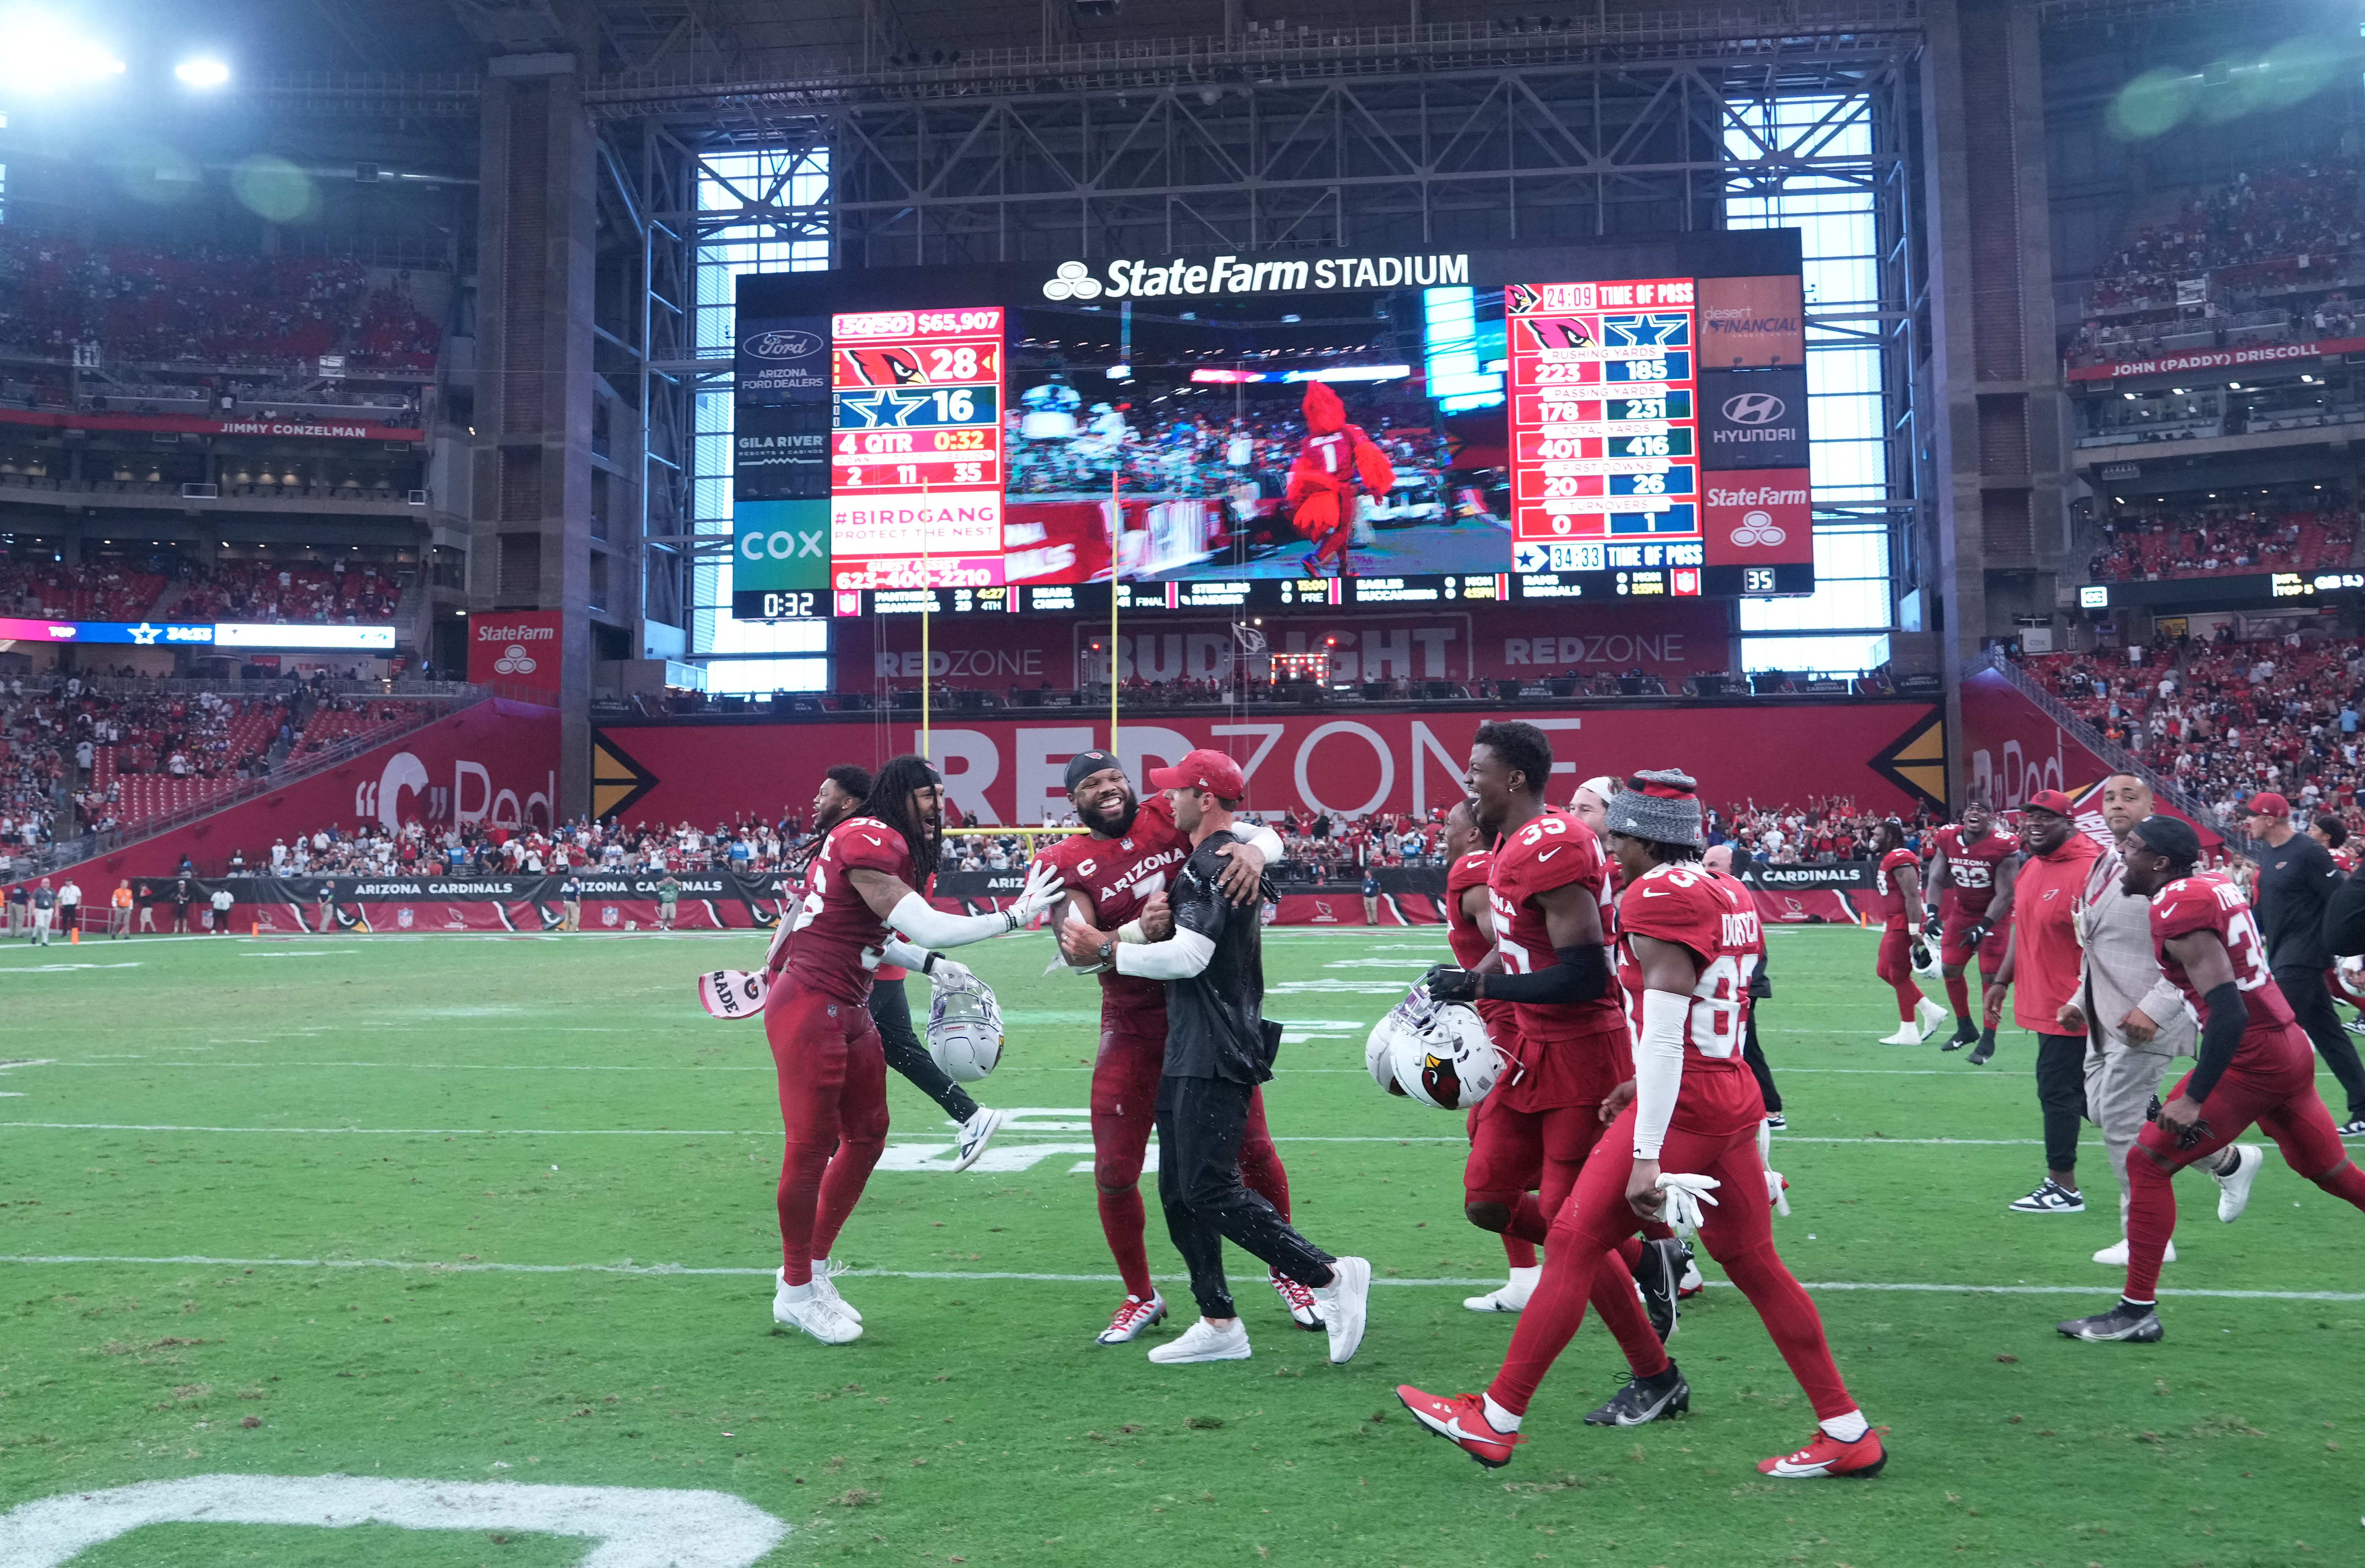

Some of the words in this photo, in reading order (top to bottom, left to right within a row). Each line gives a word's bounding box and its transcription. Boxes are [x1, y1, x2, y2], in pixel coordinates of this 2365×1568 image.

[1316, 254, 1469, 288] STADIUM
[1548, 287, 1591, 307] 24:09
[1599, 286, 1632, 305] TIME
[1636, 285, 1654, 304] OF
[1660, 283, 1693, 303] POSS
[1704, 306, 1752, 319] desert
[918, 312, 1000, 334] $65,907
[759, 334, 807, 355] Ford
[1552, 349, 1608, 359] RUSHING
[1614, 348, 1656, 358] YARDS
[2111, 362, 2156, 376] JOHN
[2160, 353, 2231, 372] (PADDY)
[2236, 344, 2320, 363] DRISCOLL
[930, 348, 978, 380] 28
[1535, 363, 1580, 383] 223
[1626, 360, 1667, 380] 185
[759, 368, 807, 378] ARIZONA
[742, 380, 772, 389] FORD
[773, 378, 824, 388] DEALERS
[1555, 388, 1608, 397] PASSING
[1614, 386, 1656, 395] YARDS
[932, 390, 974, 422] 16
[1538, 401, 1579, 421] 178
[1626, 399, 1667, 419] 231
[221, 423, 268, 433] JIMMY
[272, 424, 366, 437] CONZELMAN
[1563, 425, 1602, 435] TOTAL
[1608, 424, 1650, 433] YARDS
[1714, 427, 1795, 443] HYUNDAI
[739, 437, 773, 448] GILA
[777, 436, 823, 447] RIVER
[839, 433, 857, 454] 4
[865, 433, 912, 453] QTR
[934, 431, 984, 450] 0:32
[1537, 439, 1582, 458] 401
[1626, 436, 1669, 455] 416
[847, 467, 862, 485] 2
[897, 465, 916, 484] 11
[953, 463, 982, 482] 35
[1563, 464, 1597, 472] FIRST
[1603, 462, 1653, 471] DOWNS
[1544, 477, 1578, 497] 20
[1633, 474, 1665, 493] 26
[1570, 501, 1648, 511] TURNOVERS
[835, 507, 994, 525] #BIRDGANG
[1552, 515, 1571, 534] 0
[1644, 512, 1656, 532] 1
[835, 529, 907, 539] PROTECT
[916, 527, 946, 537] THE
[953, 527, 994, 536] NEST
[741, 530, 823, 560] COX
[1555, 548, 1598, 568] 34:33
[1607, 547, 1641, 566] TIME
[1645, 546, 1662, 566] OF
[1666, 545, 1703, 565] POSS
[866, 561, 910, 573] GUEST
[912, 560, 960, 571] ASSIST
[836, 569, 991, 589] 623-400-2210
[1191, 582, 1251, 594] STEELERS
[1281, 581, 1292, 592] 0
[1297, 579, 1328, 591] 15:00
[1357, 578, 1404, 590] EAGLES
[1445, 576, 1456, 588] 0
[1465, 576, 1493, 586] MON
[1522, 574, 1559, 586] RAMS
[1616, 572, 1628, 583] 0
[1632, 572, 1661, 582] MON
[1748, 571, 1772, 589] 35
[875, 591, 936, 602] PANTHERS
[955, 589, 972, 600] 20
[976, 588, 1006, 599] 4:27
[1032, 587, 1072, 598] BEARS
[1116, 585, 1131, 596] 10
[1191, 594, 1244, 605] RAIDERS
[1281, 592, 1292, 603] 0
[1301, 592, 1324, 602] PRE
[1357, 589, 1437, 601] BUCCANEERS
[1445, 588, 1456, 599] 0
[1523, 585, 1581, 597] BENGALS
[1616, 584, 1628, 595] 0
[764, 592, 814, 617] 0:32
[875, 601, 940, 613] SEAHAWKS
[981, 601, 1002, 610] 4TH
[1032, 598, 1075, 609] CHIEFS
[1116, 596, 1131, 607] 41
[1136, 597, 1165, 607] FINAL
[1504, 635, 1684, 665] REDZONE
[876, 649, 1043, 678] REDZONE
[1089, 634, 1233, 684] BUD
[455, 760, 554, 838] Pod
[1519, 818, 1566, 846] 35
[1077, 859, 1096, 876] C
[1948, 857, 1991, 866] ARIZONA
[1101, 848, 1186, 902] ARIZONA
[1762, 869, 1860, 882] CARDINALS
[355, 884, 421, 894] ARIZONA
[429, 883, 513, 894] CARDINALS
[560, 882, 628, 892] AIZONA
[636, 881, 722, 892] CANALS
[2152, 879, 2187, 906] 34
[744, 977, 759, 1000] G
